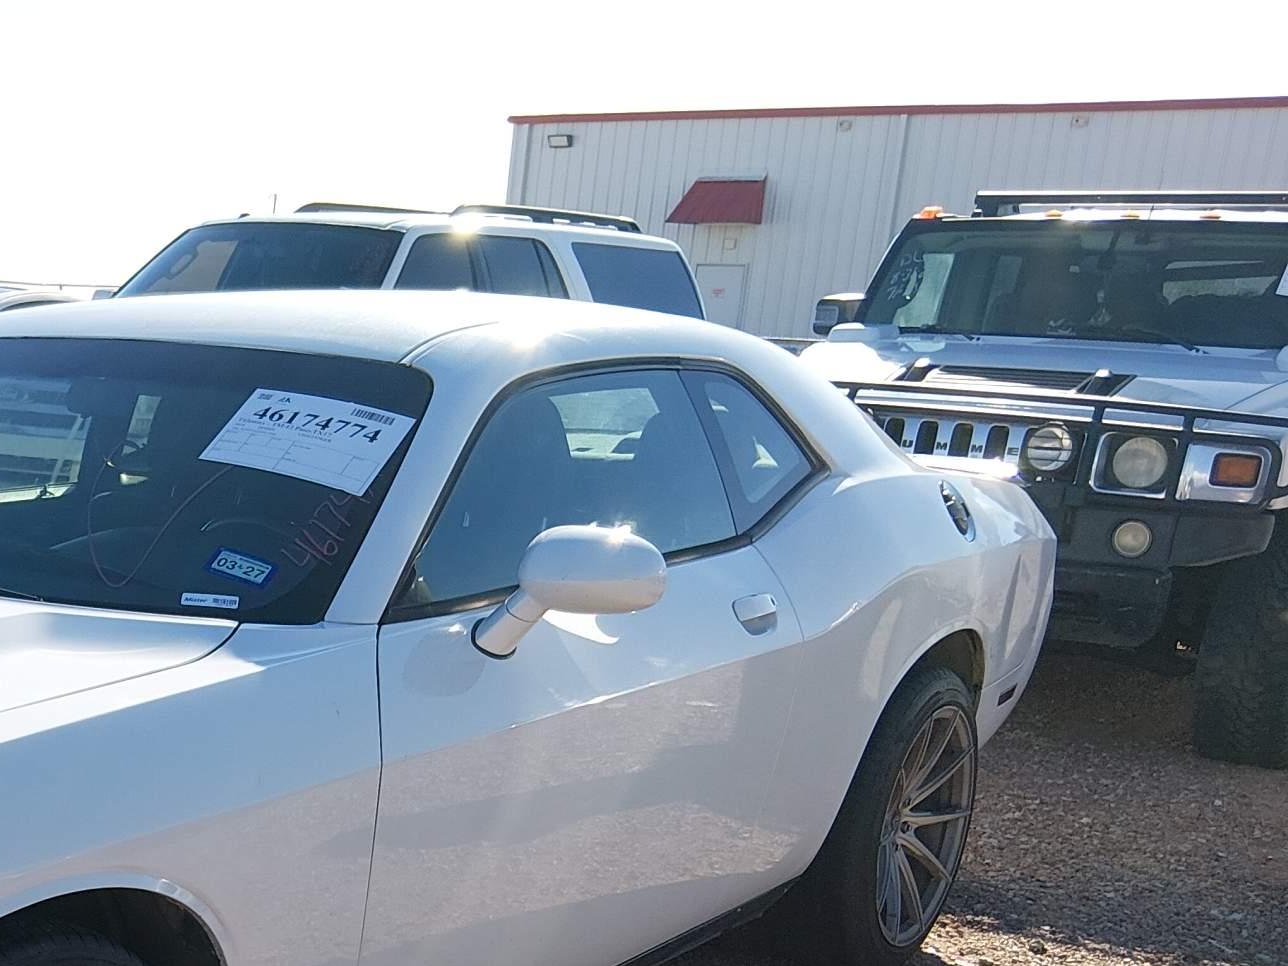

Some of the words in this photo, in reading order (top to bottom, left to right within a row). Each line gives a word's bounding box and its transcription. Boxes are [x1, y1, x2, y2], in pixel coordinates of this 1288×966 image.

[253, 405, 383, 443] 46174774
[216, 557, 238, 571] 03
[242, 566, 266, 579] 27
